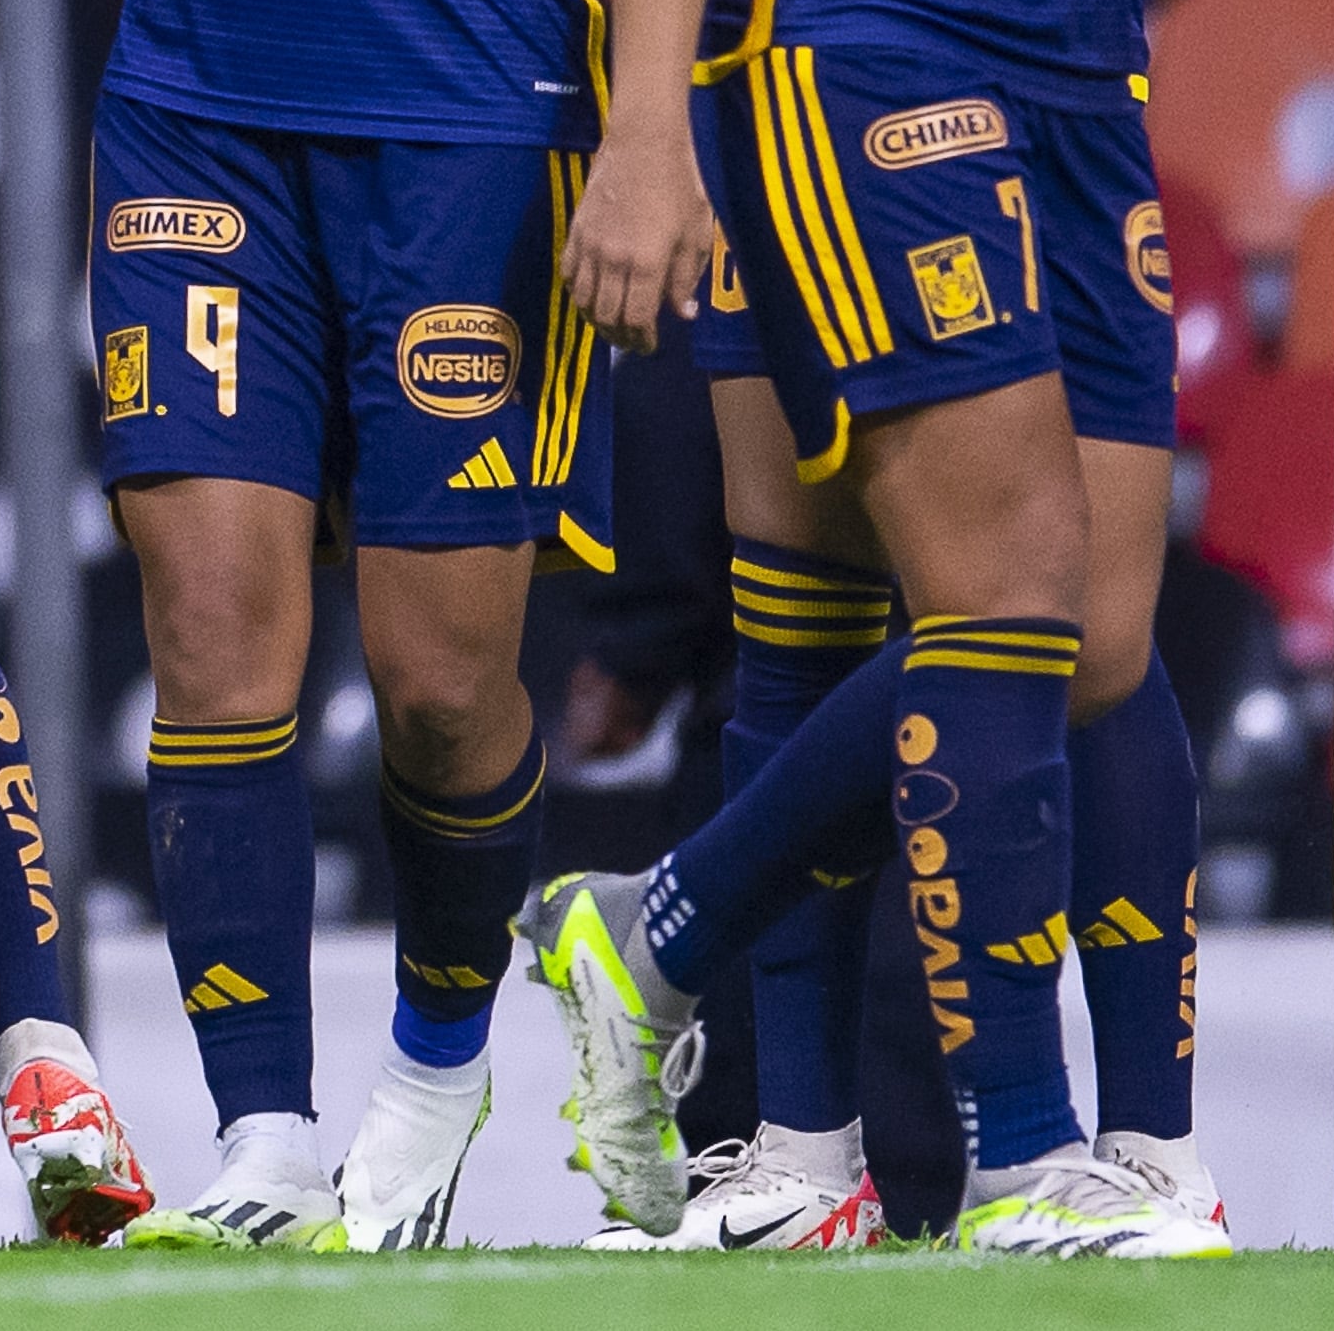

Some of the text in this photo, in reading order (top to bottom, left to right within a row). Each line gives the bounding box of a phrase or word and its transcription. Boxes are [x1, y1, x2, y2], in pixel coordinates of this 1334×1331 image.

[113, 211, 224, 239] CHIMEX
[995, 176, 1040, 313] 7
[186, 284, 240, 418] 9
[425, 318, 501, 335] HELADOS
